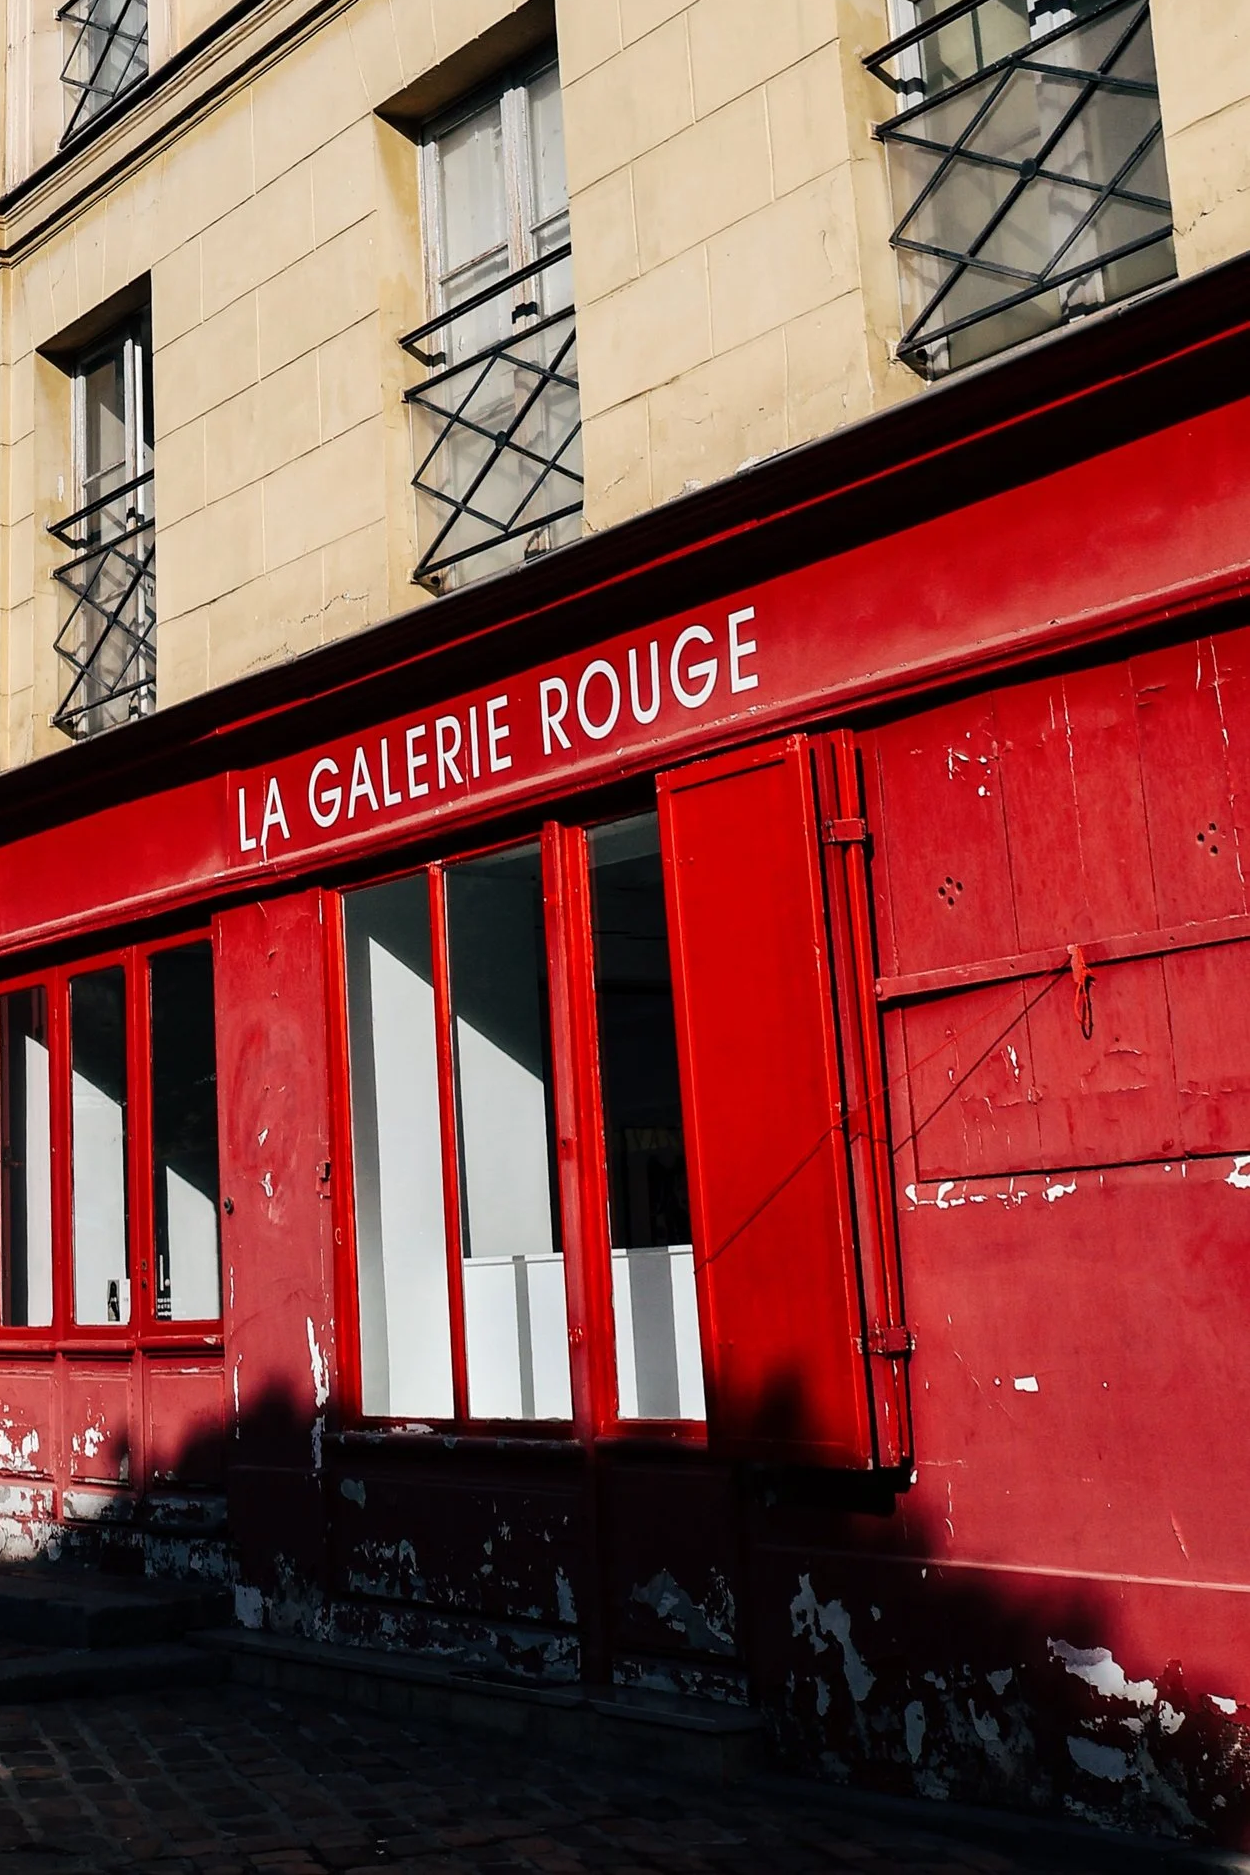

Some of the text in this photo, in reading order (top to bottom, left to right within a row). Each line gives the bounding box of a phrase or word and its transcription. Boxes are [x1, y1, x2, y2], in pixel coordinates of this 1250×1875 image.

[238, 606, 760, 852] LA GALERIE ROUGE
